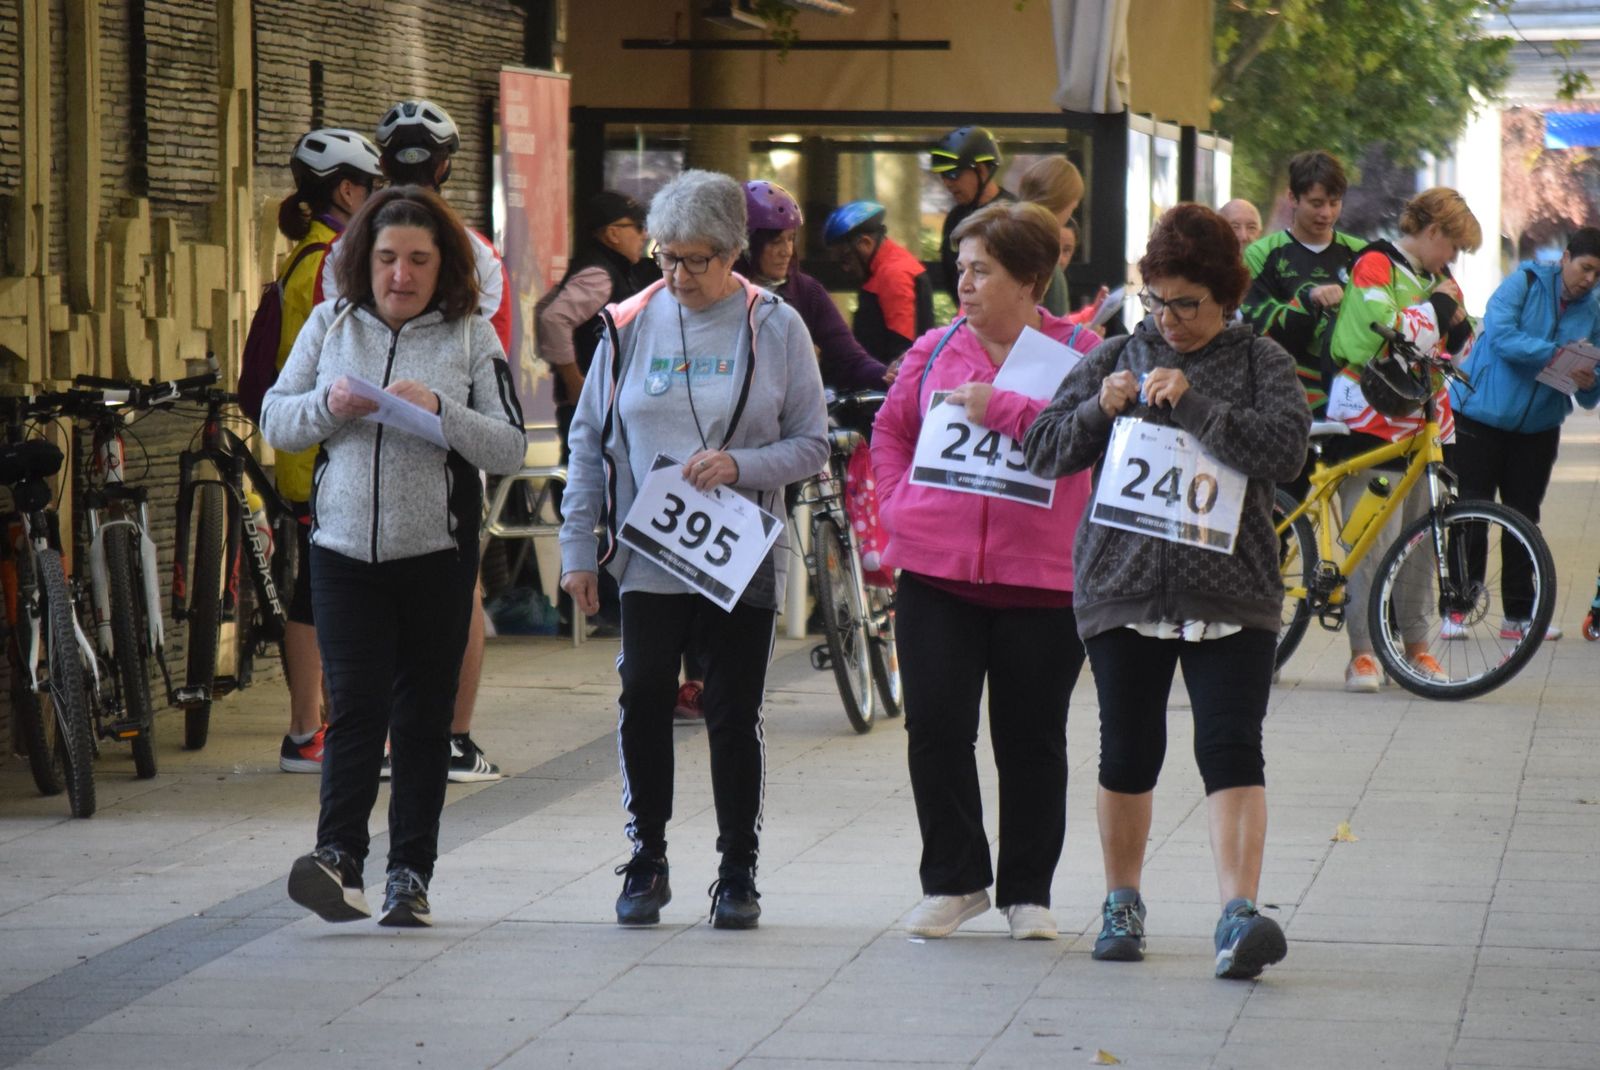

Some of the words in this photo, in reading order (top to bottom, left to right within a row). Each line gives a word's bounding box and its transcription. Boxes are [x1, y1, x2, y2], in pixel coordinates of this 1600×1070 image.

[940, 421, 1026, 472] 245
[1120, 457, 1219, 516] 240
[650, 492, 741, 568] 395
